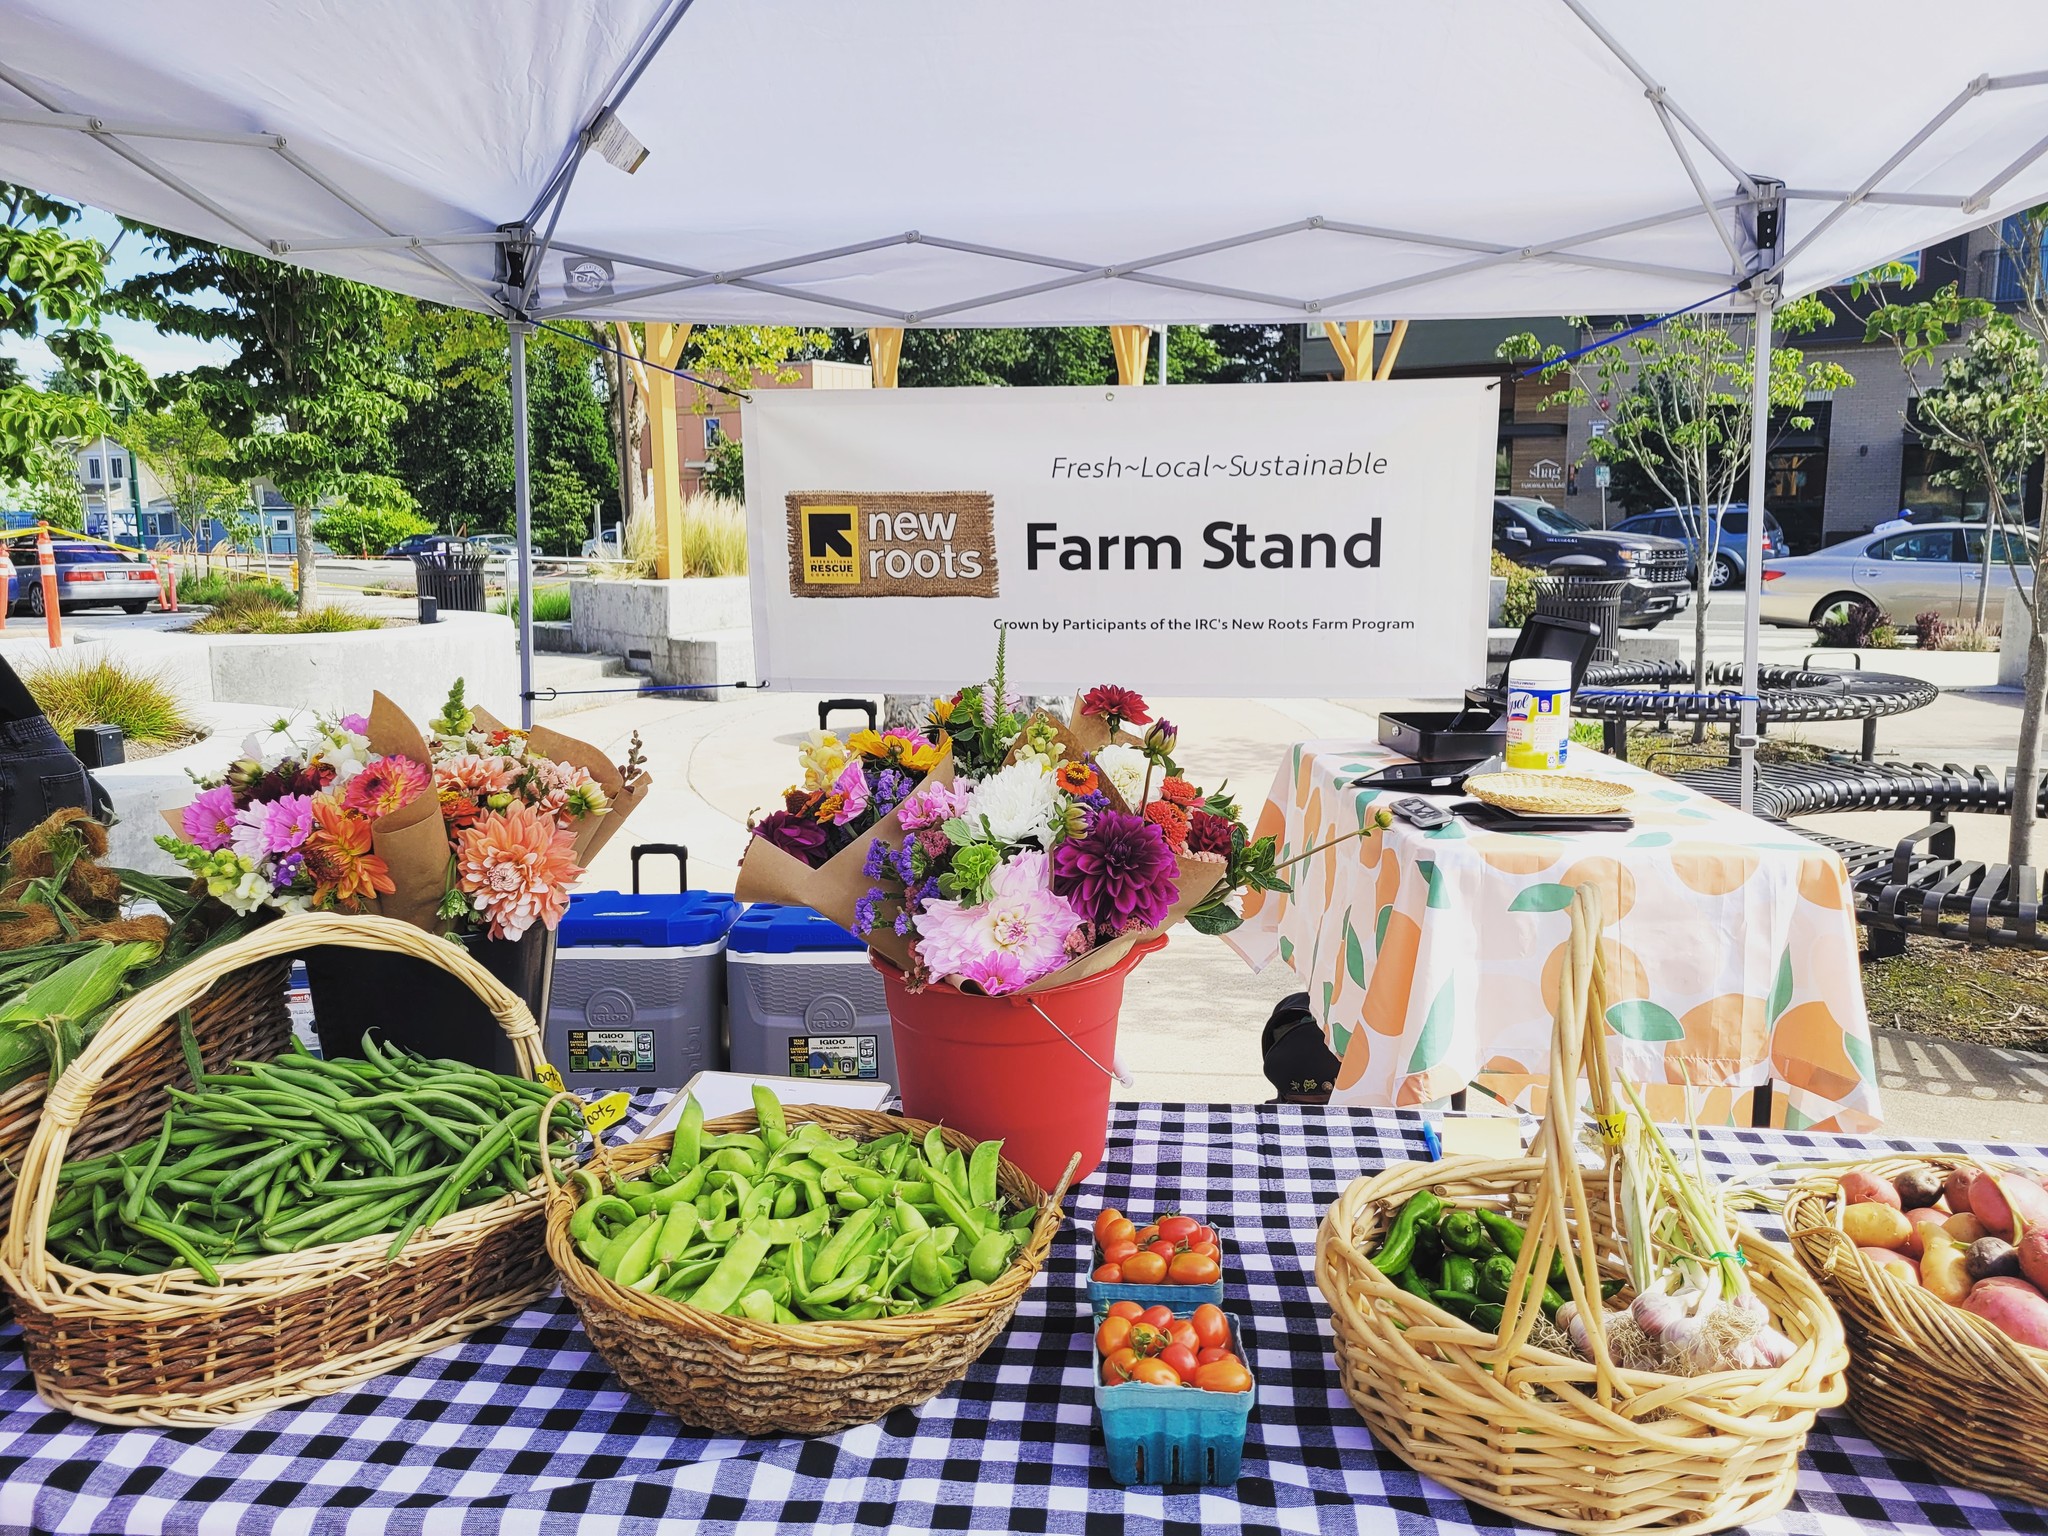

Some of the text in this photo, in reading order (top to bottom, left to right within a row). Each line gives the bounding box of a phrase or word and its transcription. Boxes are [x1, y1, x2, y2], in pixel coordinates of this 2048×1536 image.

[1051, 452, 1388, 479] Fresh~Local~Sustainable
[868, 511, 957, 541] new
[1027, 517, 1382, 571] Farm Stand
[810, 564, 854, 573] RESCUE
[868, 543, 984, 579] roots
[993, 618, 1415, 633] Grown by Participants of the IRC's New Roots Farm Program
[1509, 694, 1530, 711] ysol
[592, 1013, 629, 1023] IGLOO
[811, 1020, 849, 1029] IGLOO
